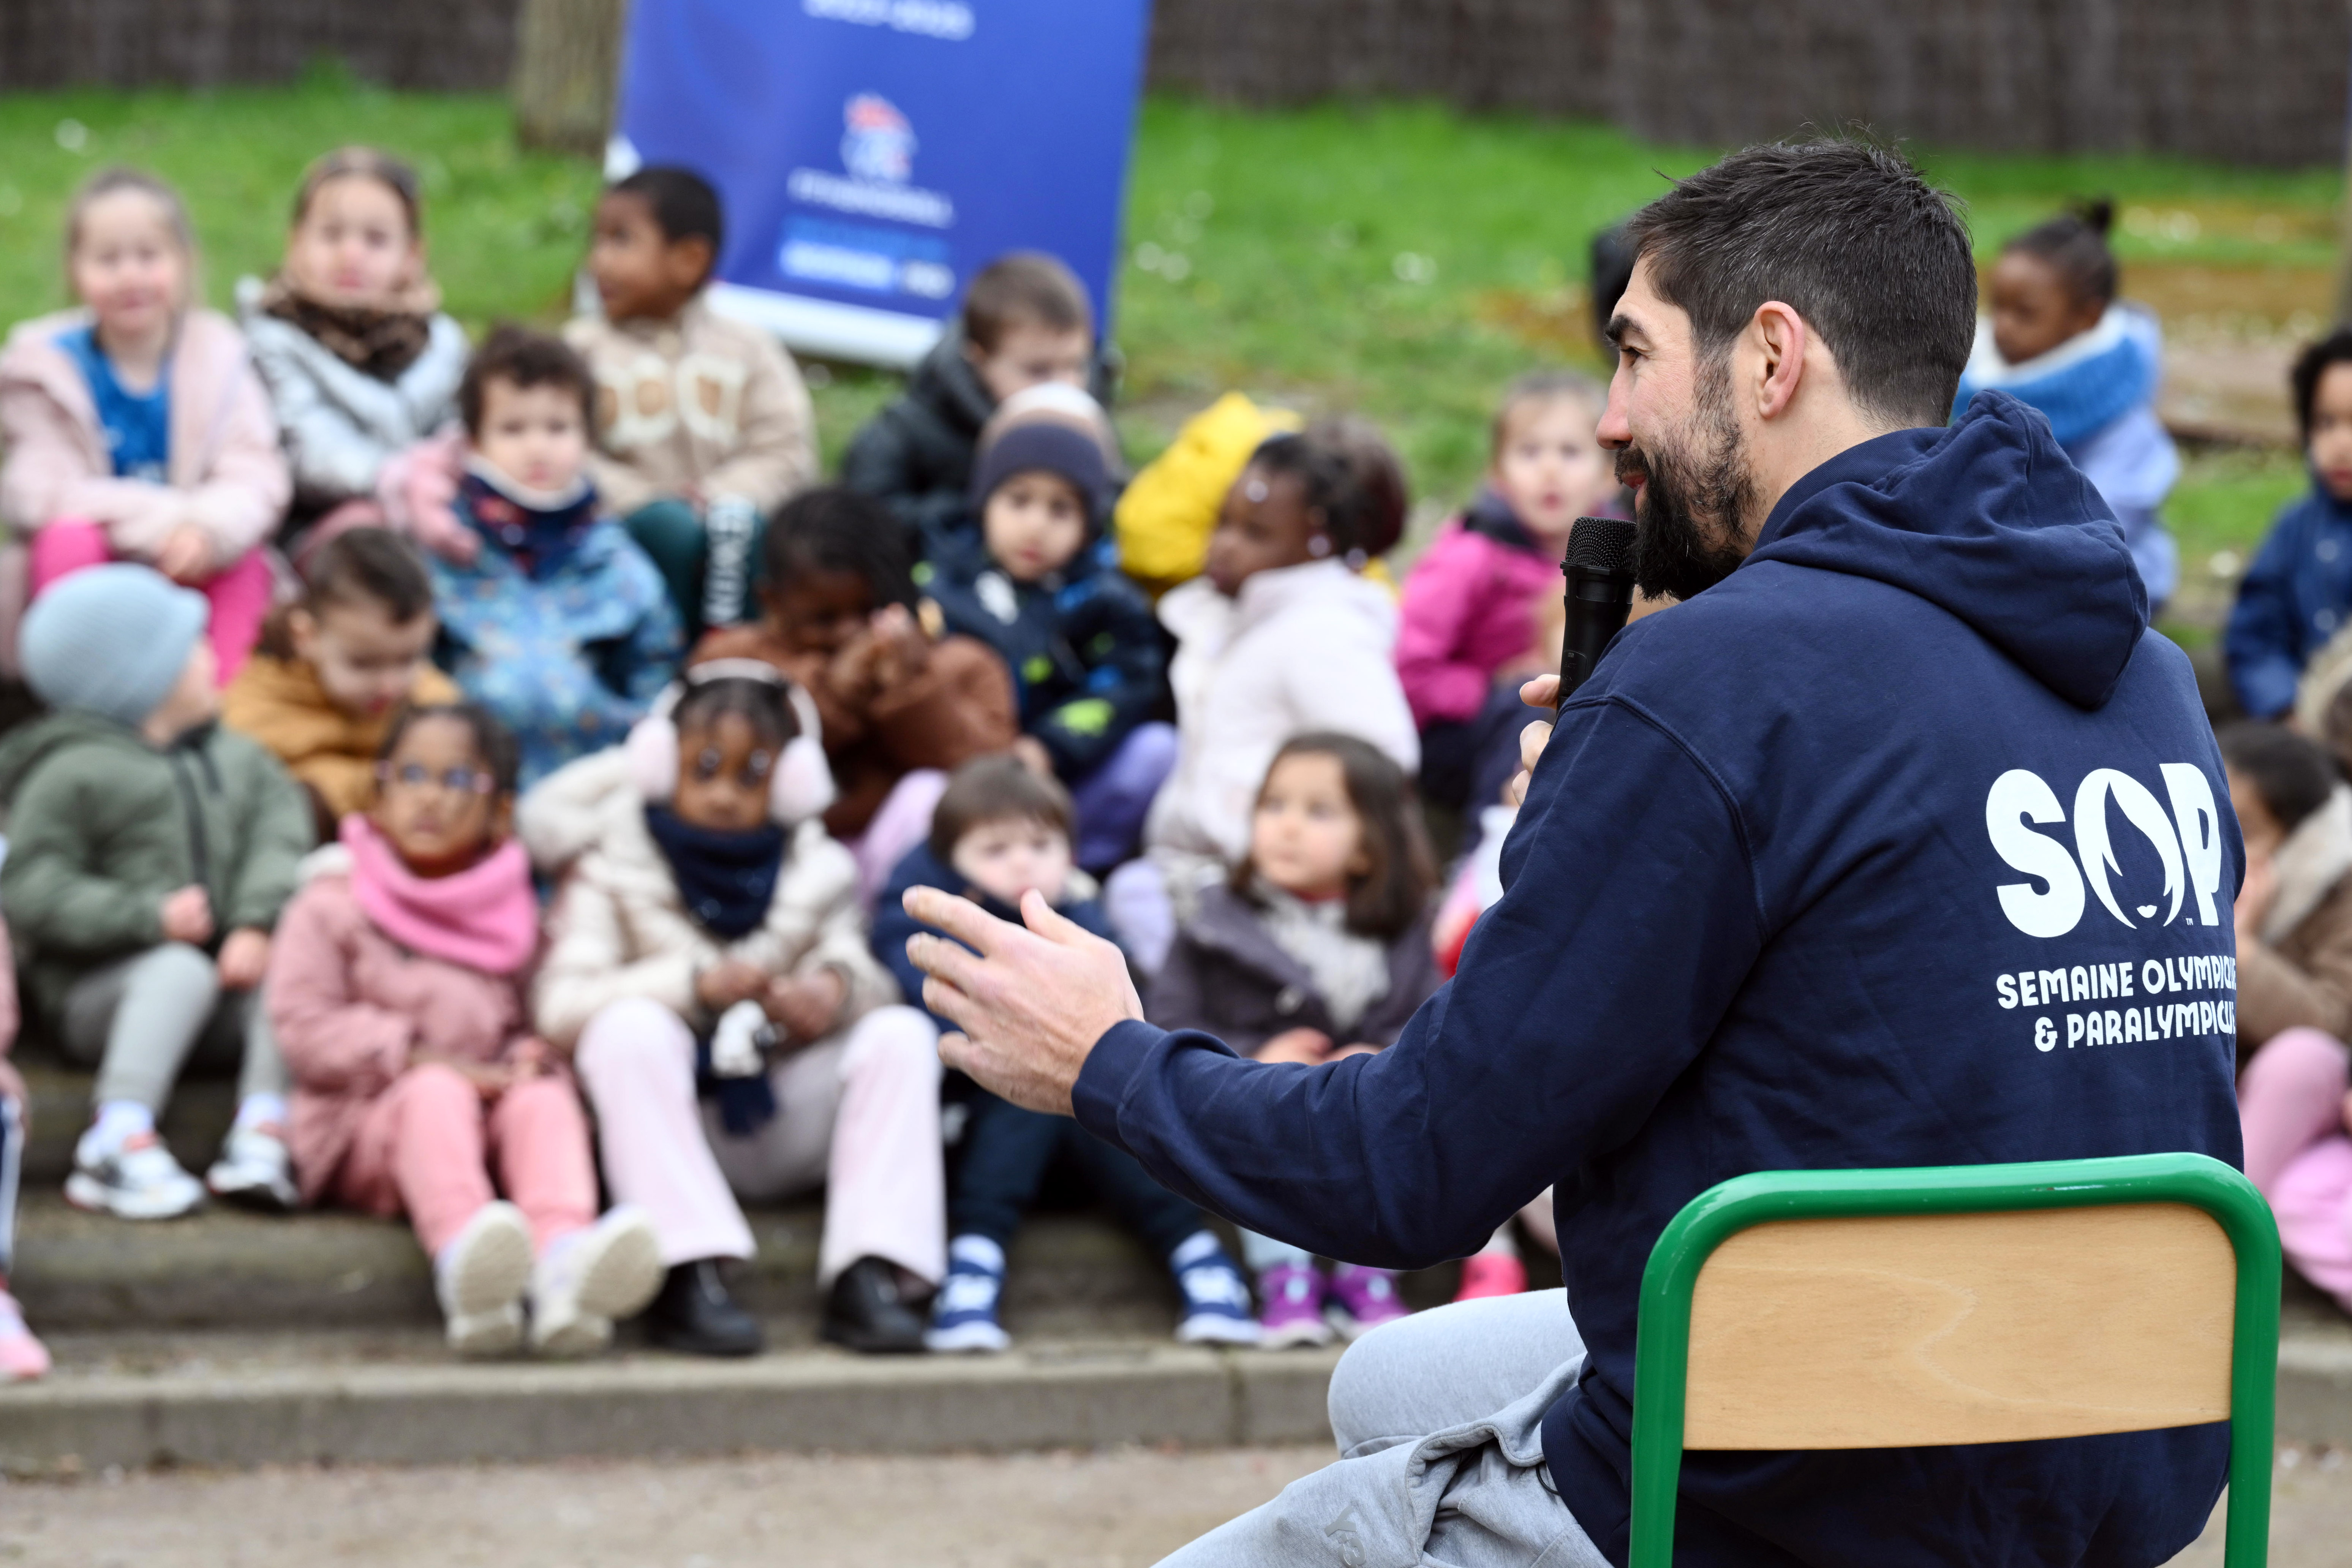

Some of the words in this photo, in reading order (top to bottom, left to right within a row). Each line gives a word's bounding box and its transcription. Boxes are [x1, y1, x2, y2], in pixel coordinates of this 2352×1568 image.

[1986, 763, 2222, 938] SOP
[1996, 962, 2134, 1009] SEMAINE
[2035, 1017, 2058, 1052] &
[1323, 1503, 1366, 1568] Y-3
